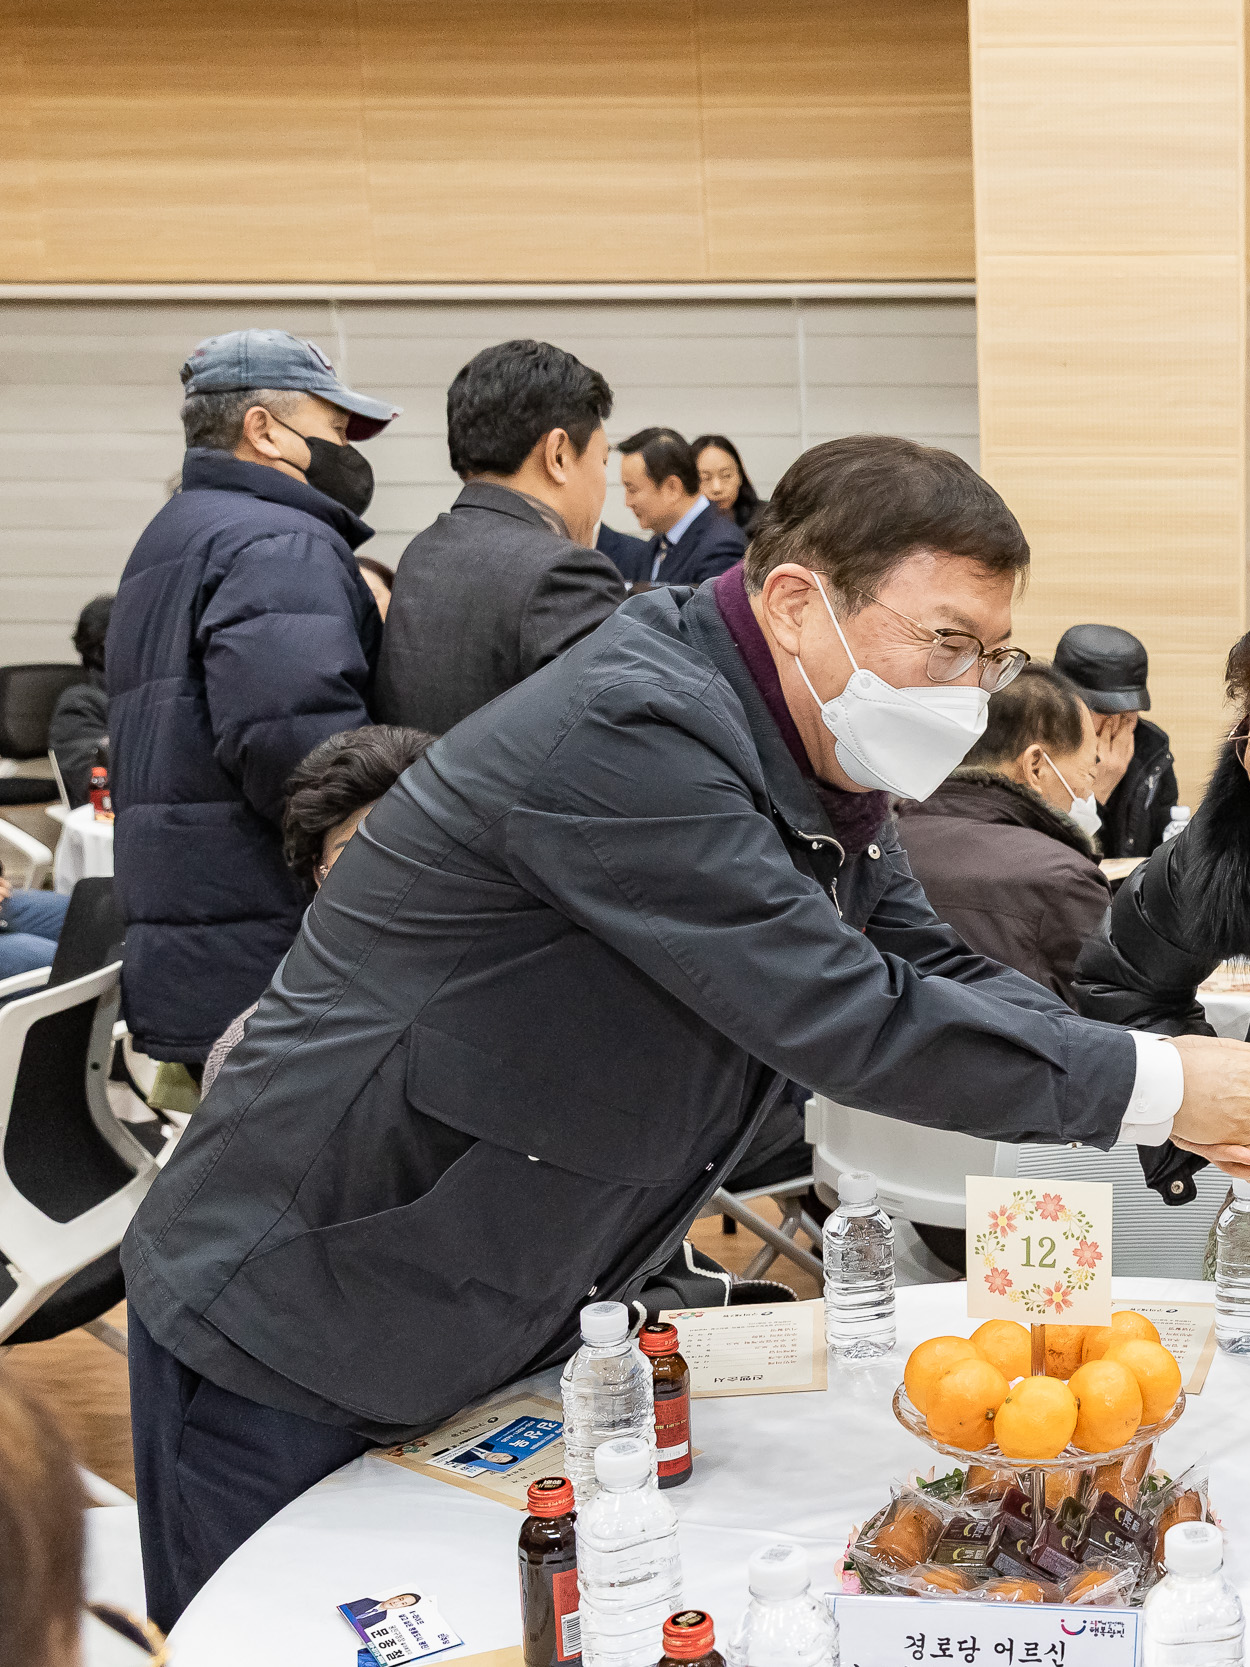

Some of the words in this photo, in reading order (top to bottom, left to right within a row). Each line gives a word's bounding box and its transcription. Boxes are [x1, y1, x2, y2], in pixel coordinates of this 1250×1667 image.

[1021, 1236, 1056, 1268] 12
[904, 1633, 980, 1662] 경로당
[994, 1638, 1067, 1667] 어르신
